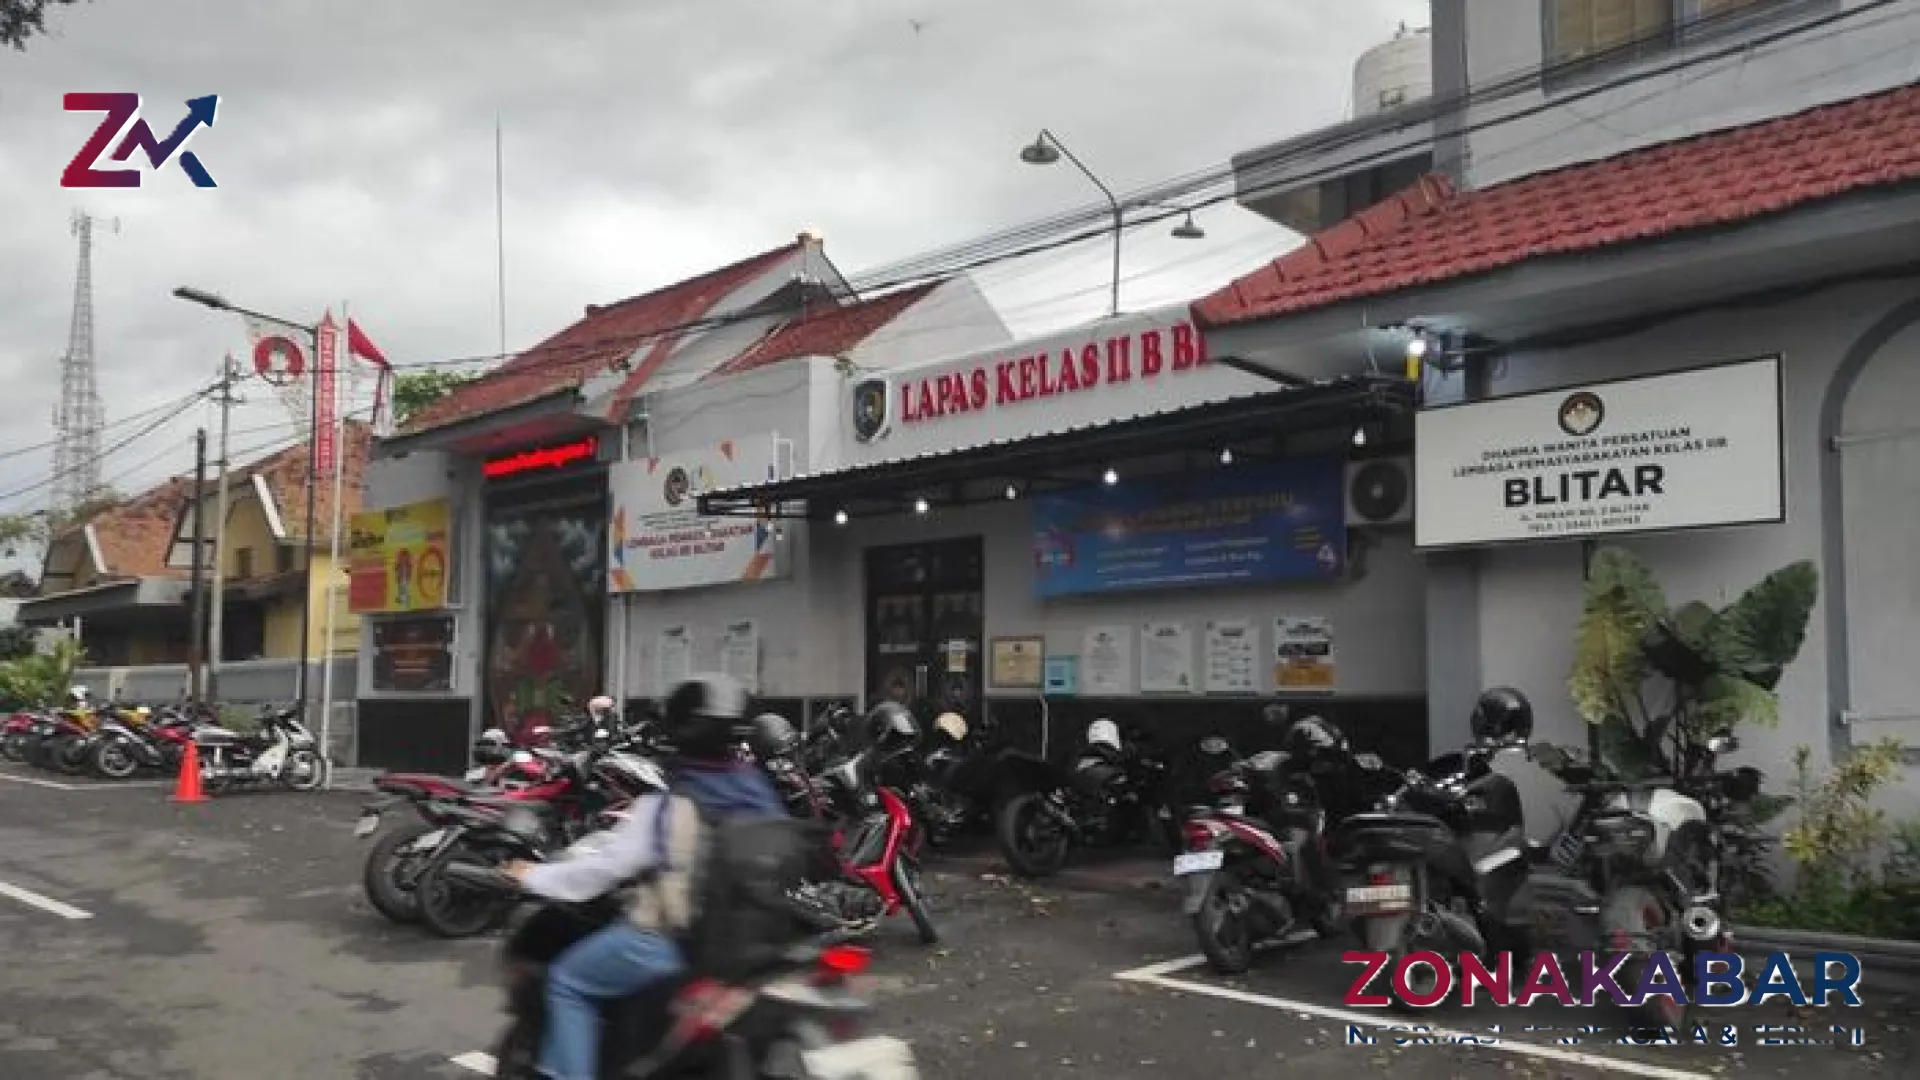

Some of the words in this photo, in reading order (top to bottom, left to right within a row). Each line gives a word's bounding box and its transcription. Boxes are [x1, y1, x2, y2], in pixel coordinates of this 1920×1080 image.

[901, 368, 988, 423] LAPAS
[995, 344, 1099, 405] KELAS
[1140, 330, 1163, 379] B
[1601, 427, 1690, 445] PERSATUAN
[1453, 461, 1515, 478] LEMBAGA
[1517, 446, 1650, 470] PEMASYARAKATAN
[1653, 440, 1703, 456] KELAS
[1504, 463, 1664, 507] BLITAR
